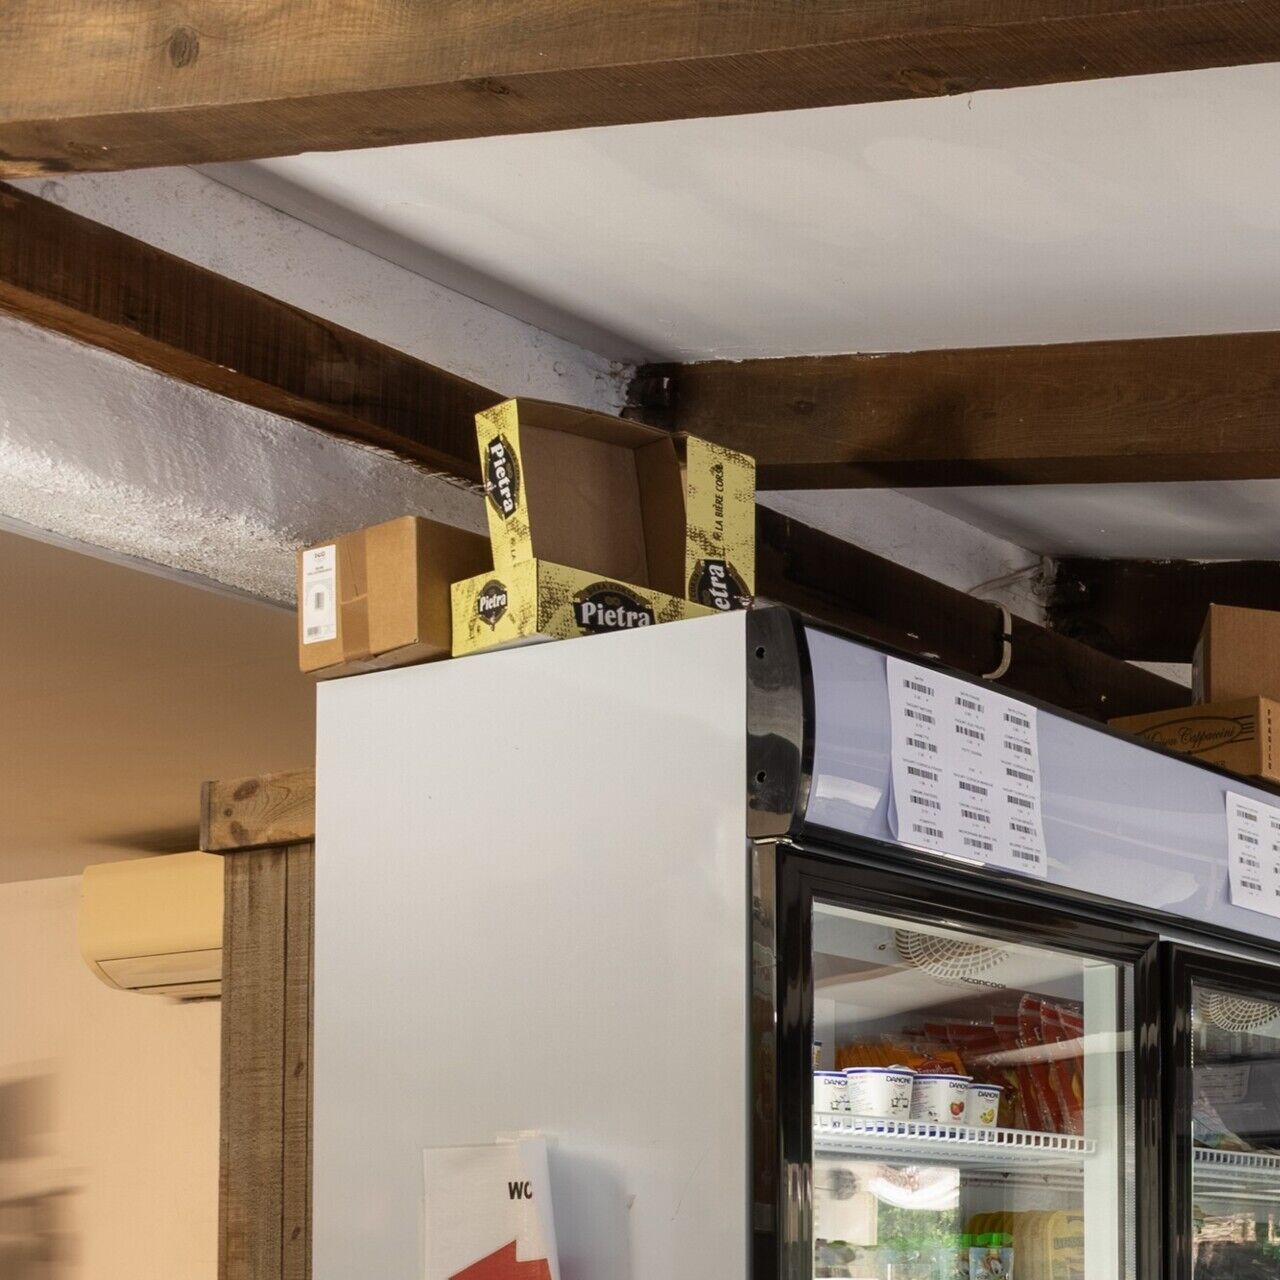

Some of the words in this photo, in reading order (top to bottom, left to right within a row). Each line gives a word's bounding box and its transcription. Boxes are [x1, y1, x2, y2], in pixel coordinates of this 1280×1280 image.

[489, 442, 514, 513] Pietra
[479, 593, 507, 614] Pietra
[581, 601, 651, 628] Pietra
[508, 1180, 533, 1200] WC
